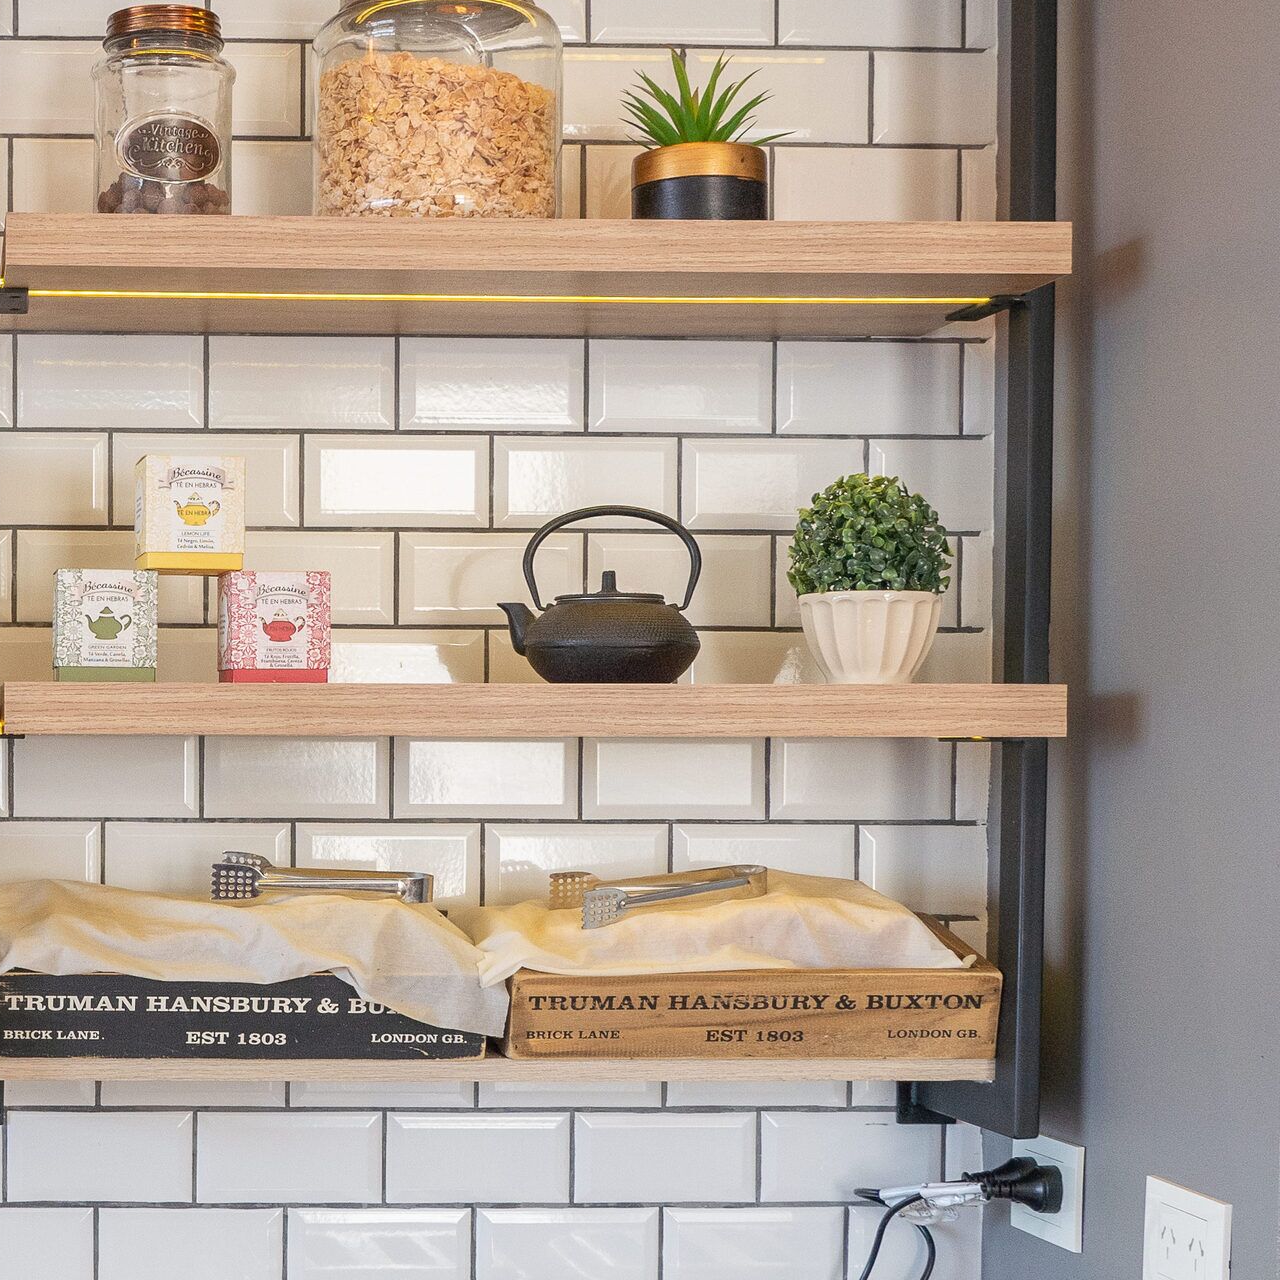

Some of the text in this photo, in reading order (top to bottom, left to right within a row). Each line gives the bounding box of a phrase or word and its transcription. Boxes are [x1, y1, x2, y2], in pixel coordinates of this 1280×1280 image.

[151, 124, 199, 139] Vintage
[142, 136, 203, 155] Kitchen
[171, 467, 222, 480] Bécassine
[83, 581, 133, 594] Bécassine
[256, 583, 307, 597] Bécassine
[4, 995, 138, 1012] TRUMAN
[146, 996, 310, 1014] HANSBURY
[317, 998, 340, 1015] &
[528, 994, 985, 1011] TRUMAN HANSBURY & BUXTON
[3, 1030, 53, 1040] BRICK
[185, 1031, 287, 1046] EST 1803
[370, 1033, 468, 1044] LONDON GB.
[525, 1030, 573, 1040] BRICK
[705, 1029, 804, 1043] EST 1803
[887, 1029, 952, 1039] LONDON
